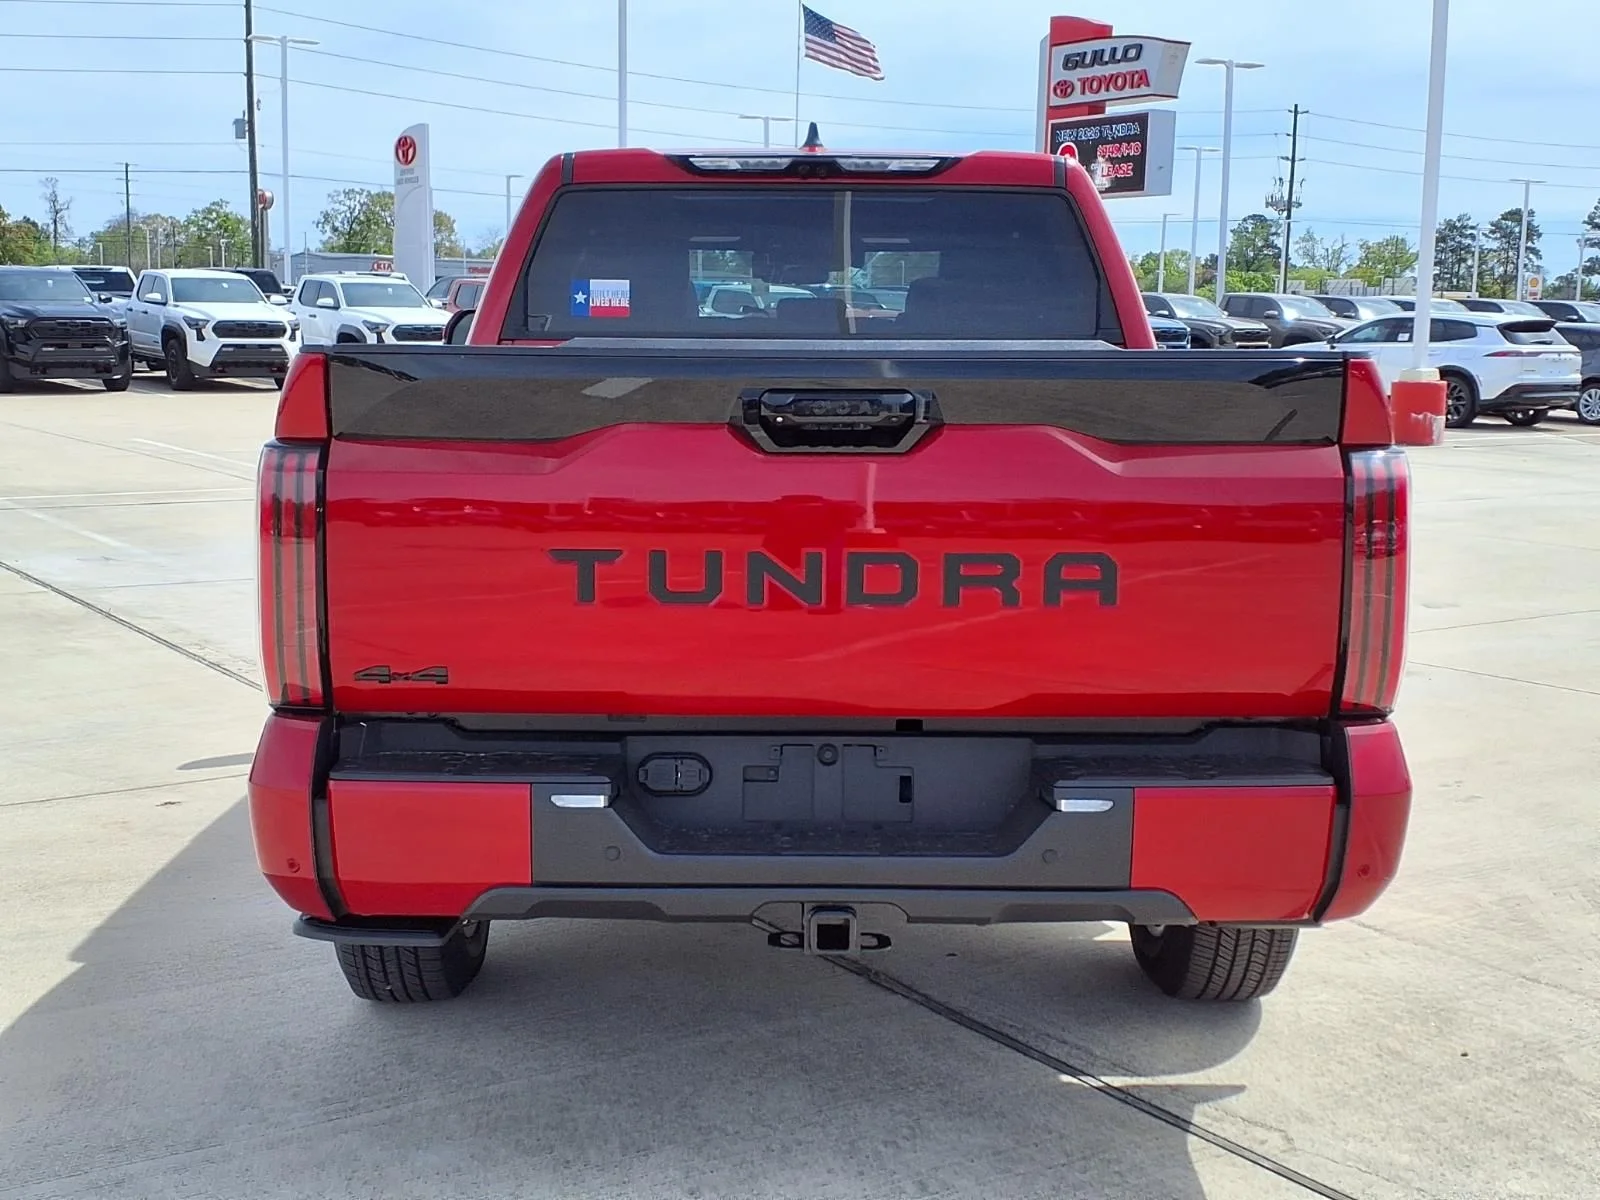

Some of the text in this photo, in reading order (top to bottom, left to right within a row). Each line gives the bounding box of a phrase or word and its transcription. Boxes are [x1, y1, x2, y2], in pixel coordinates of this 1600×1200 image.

[1062, 43, 1143, 71] GULLO
[1077, 69, 1150, 95] TOYOTA
[1056, 129, 1077, 143] NEW
[1101, 122, 1140, 139] TUNDRA
[1101, 163, 1134, 178] LEASE
[376, 262, 393, 271] KIA
[590, 297, 630, 307] LIVES HERE
[548, 549, 1119, 607] TUNDRA
